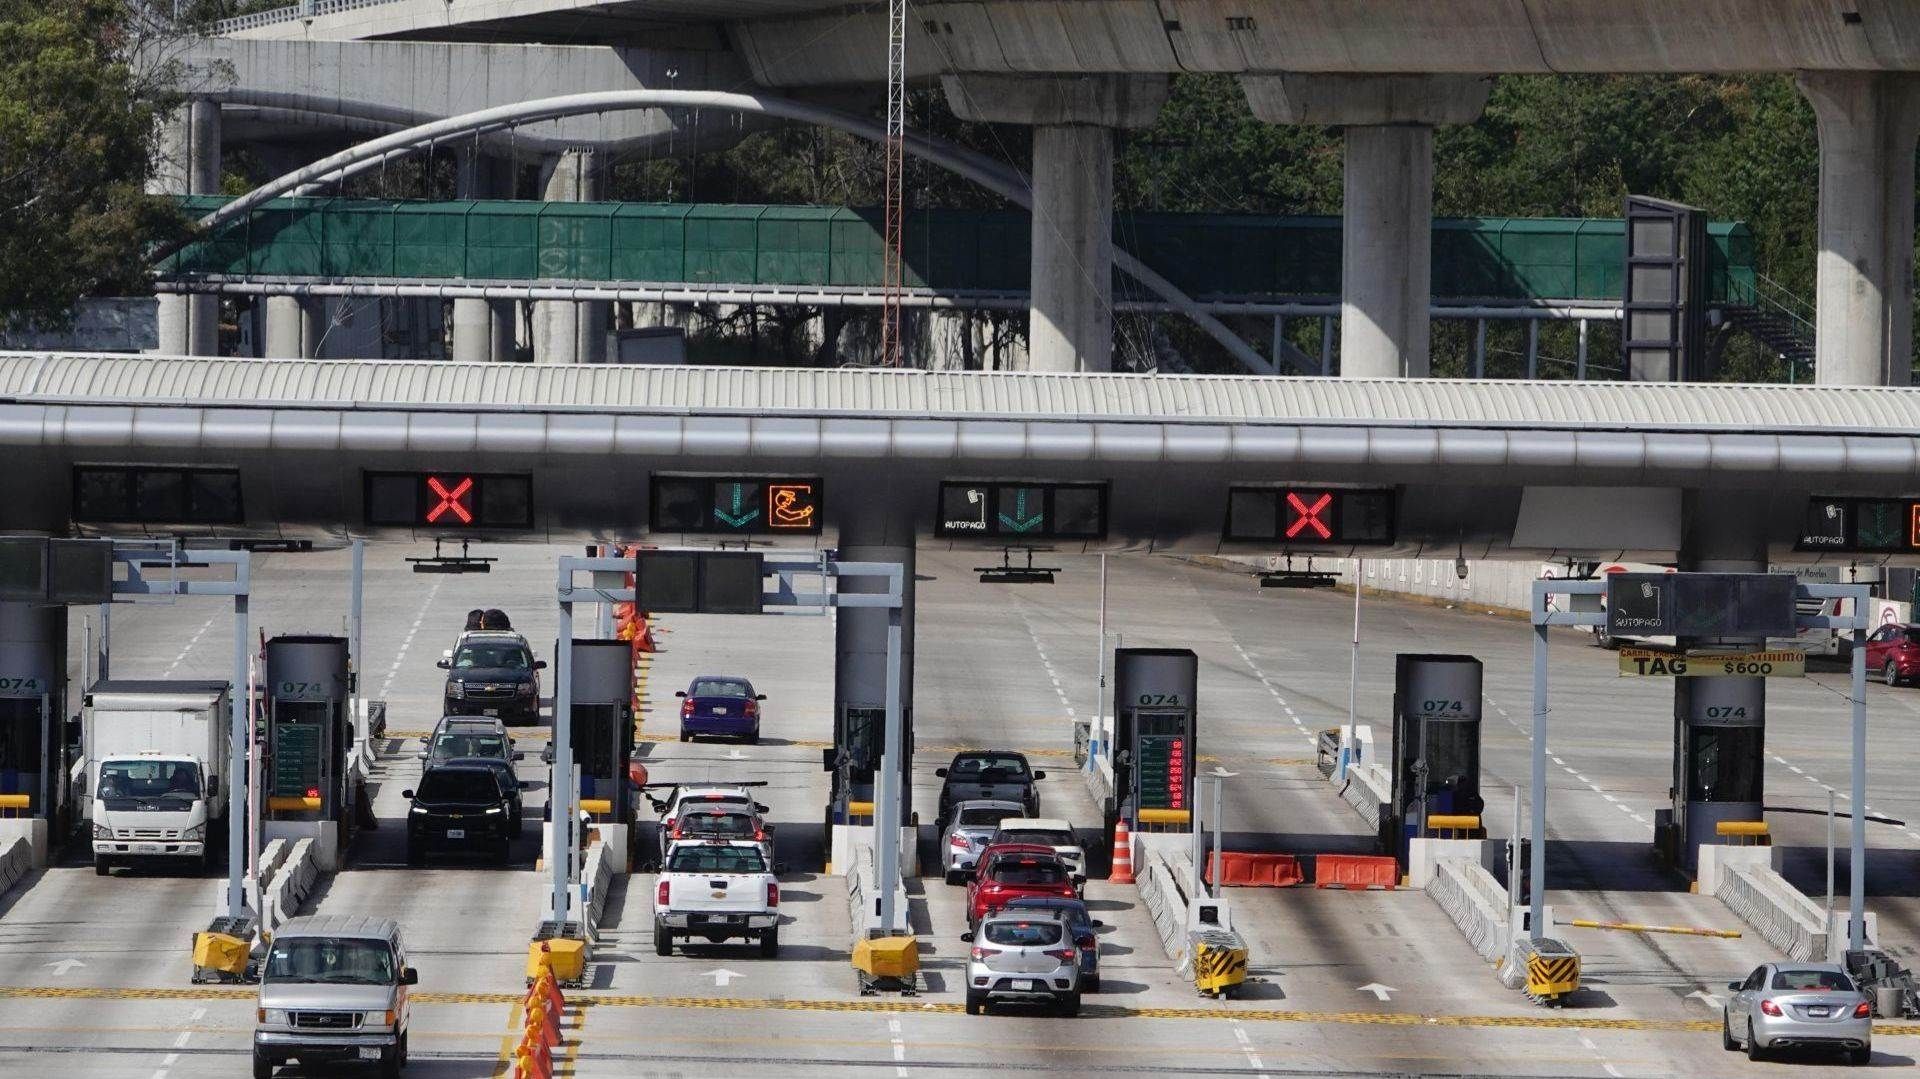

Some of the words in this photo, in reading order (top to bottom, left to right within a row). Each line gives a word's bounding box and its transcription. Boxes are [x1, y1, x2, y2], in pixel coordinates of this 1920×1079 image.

[945, 521, 986, 529] AUTOPAGO
[1804, 536, 1845, 544] AUTOPAGO
[1615, 617, 1662, 627] AUTOPAGO
[1633, 657, 1687, 675] TAG
[1724, 661, 1773, 674] $600
[0, 678, 37, 690] 074
[283, 682, 322, 693] 074
[1140, 694, 1179, 705] 074
[1423, 700, 1463, 711] 074
[1707, 706, 1746, 718] 074
